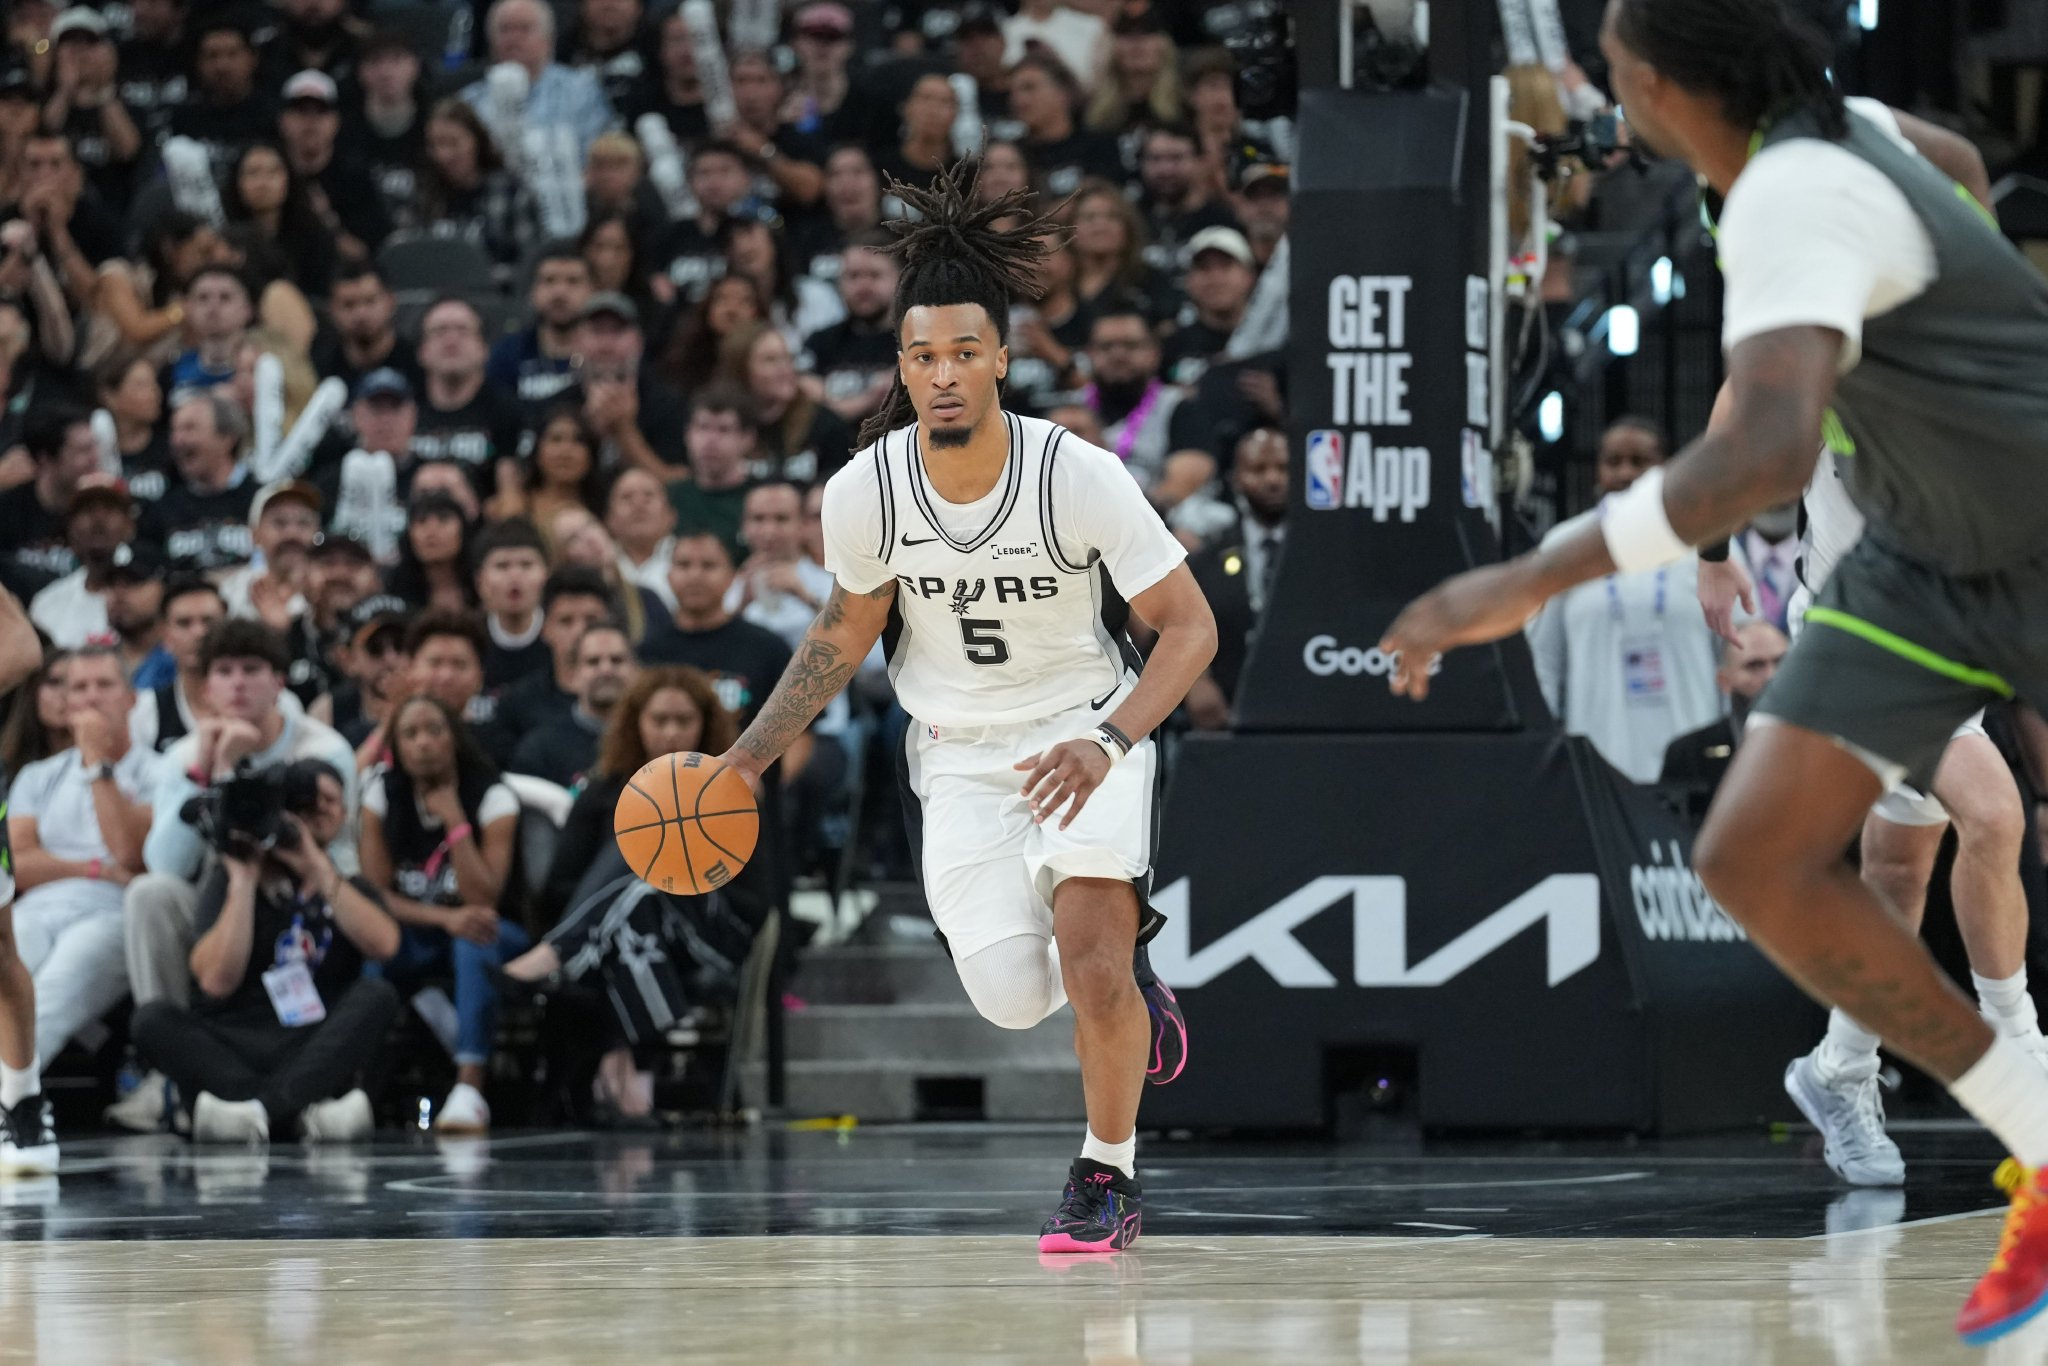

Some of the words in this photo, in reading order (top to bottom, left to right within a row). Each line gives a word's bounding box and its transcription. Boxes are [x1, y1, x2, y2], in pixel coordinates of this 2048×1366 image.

[1328, 274, 1412, 349] GET
[1326, 352, 1412, 425] THE
[1344, 431, 1430, 522] App
[997, 547, 1032, 555] LEDGER
[957, 616, 1011, 667] 5
[1148, 873, 1600, 989] KIA
